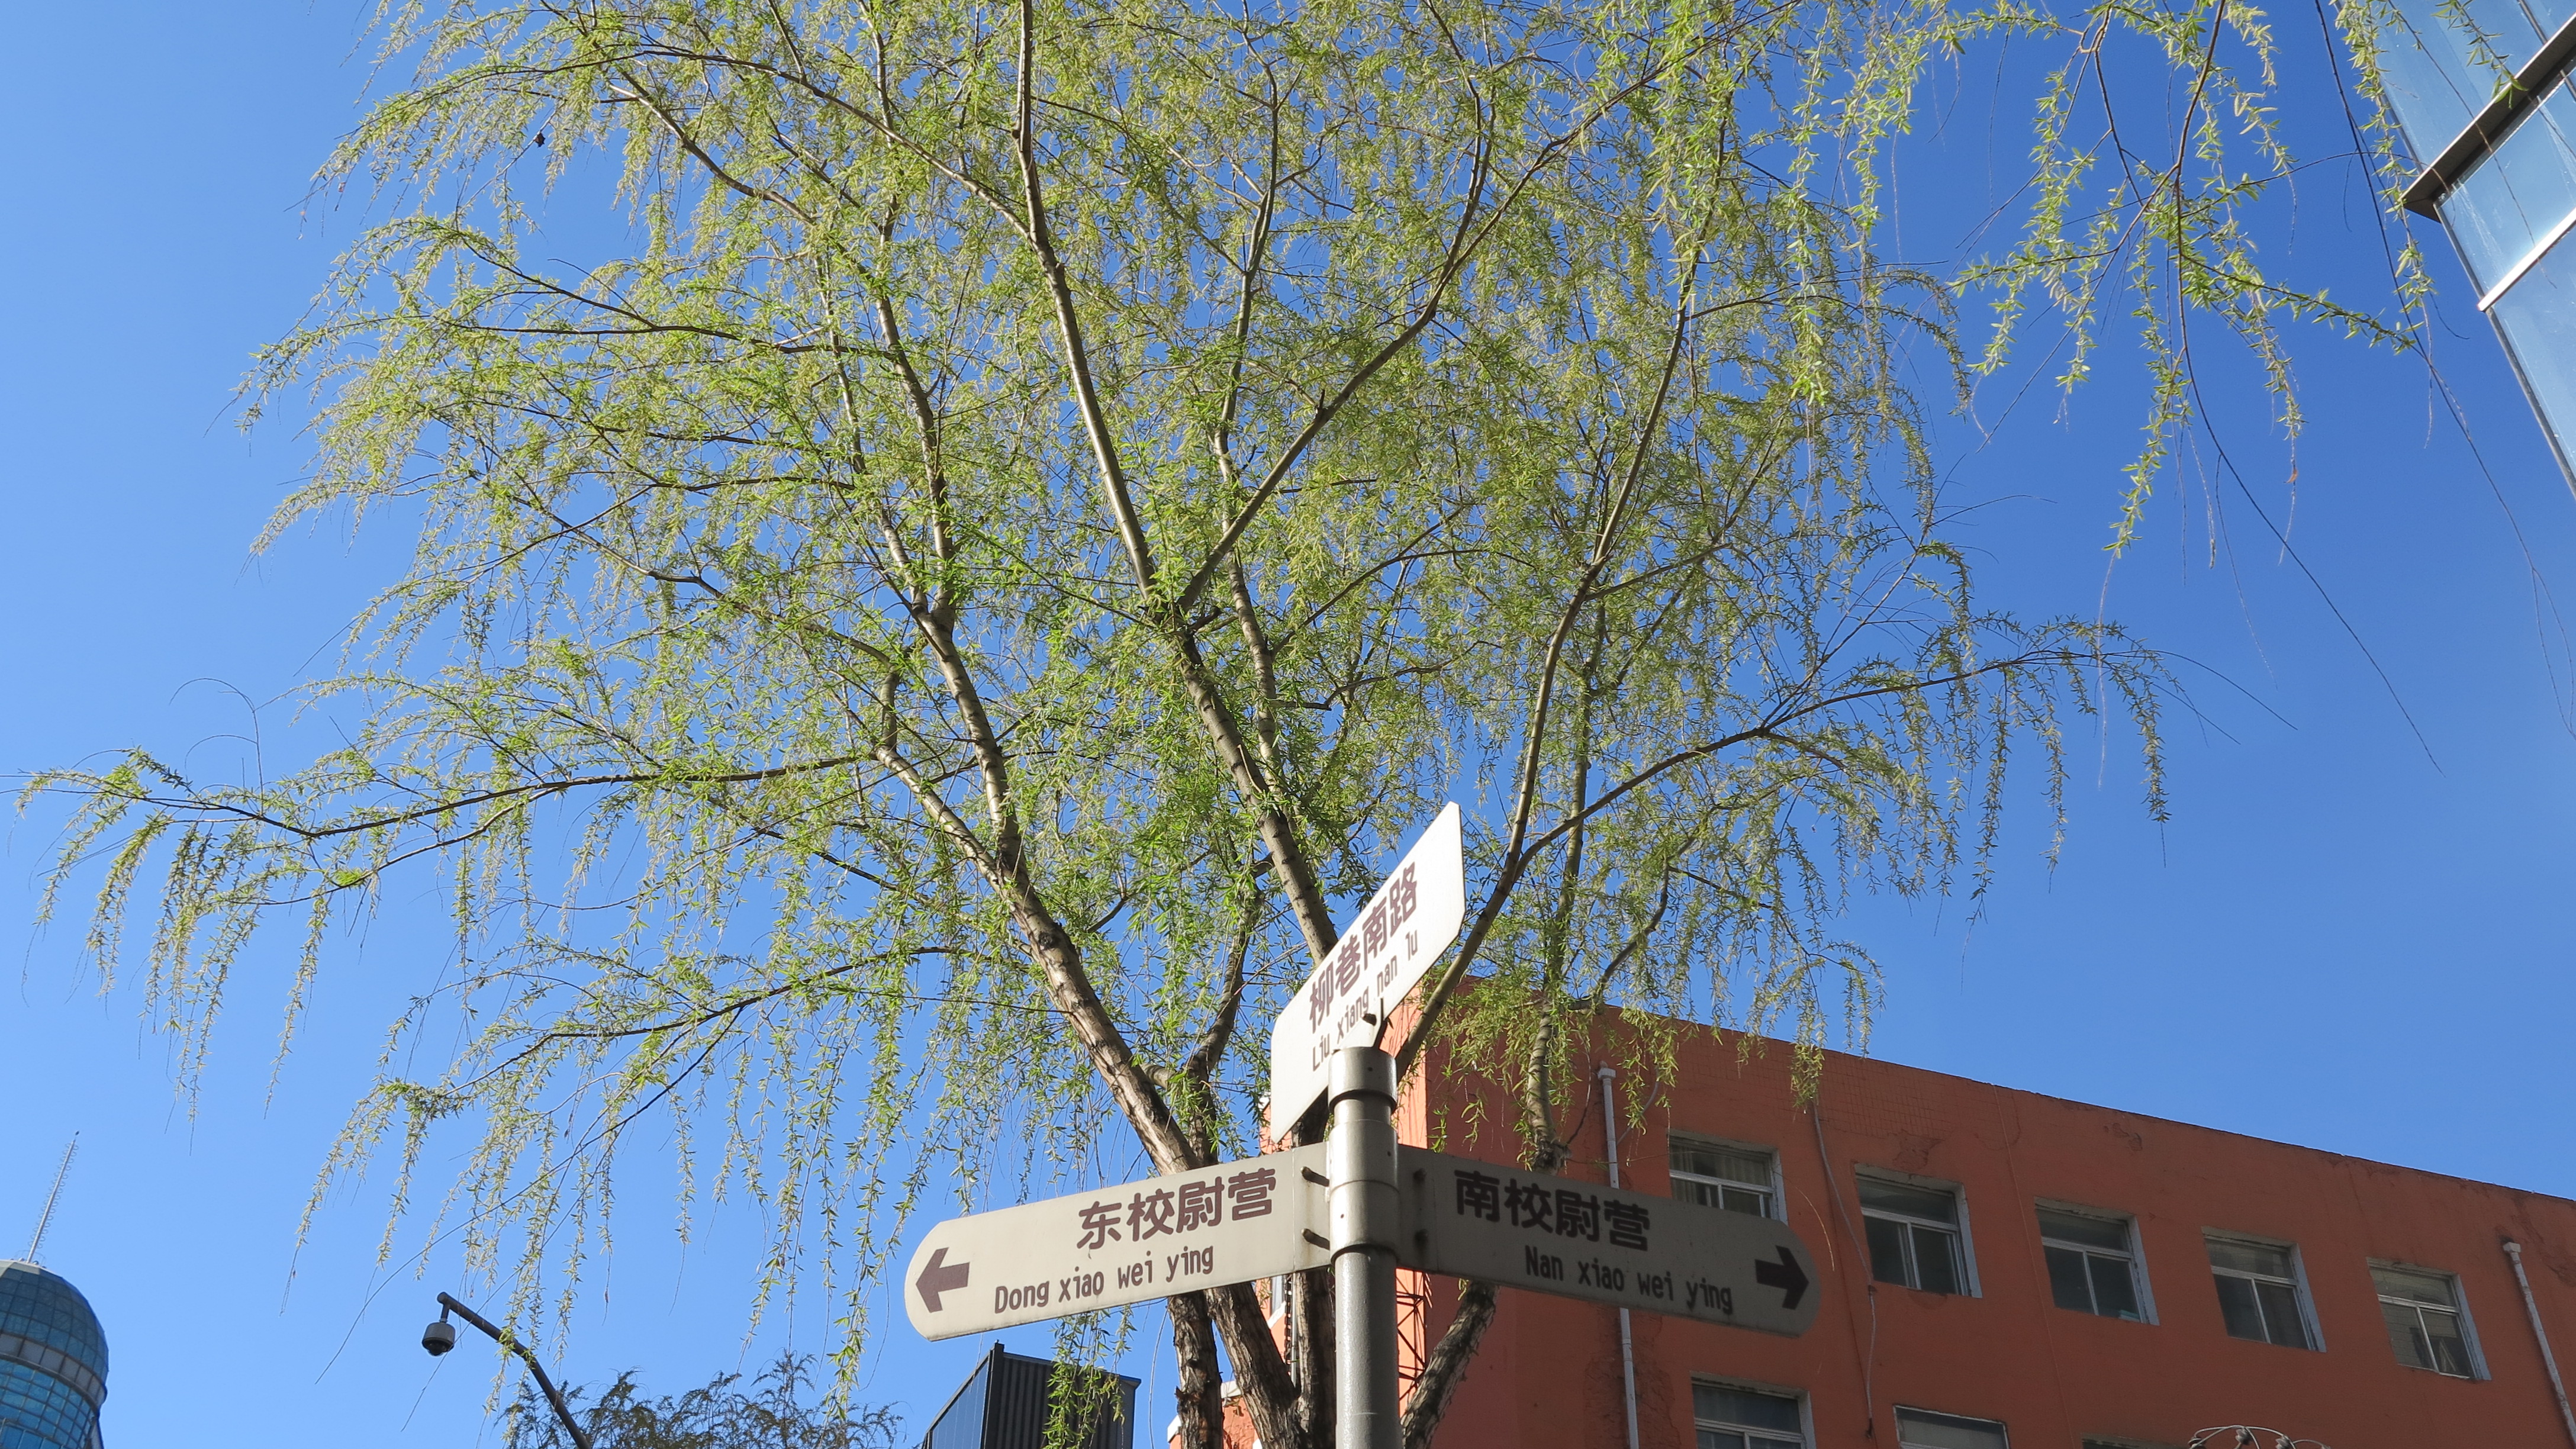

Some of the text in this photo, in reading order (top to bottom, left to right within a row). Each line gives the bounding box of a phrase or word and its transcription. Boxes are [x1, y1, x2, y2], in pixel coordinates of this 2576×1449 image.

[1309, 862, 1418, 1033] 柳巷南路
[1312, 929, 1418, 1071] Liu xiang nan lu
[1077, 1167, 1276, 1250] 东校尉营
[1454, 1169, 1650, 1251] 南校尉营
[994, 1246, 1214, 1313] Dong xiao wei ying
[1525, 1245, 1733, 1315] Nan xiao wei ying
